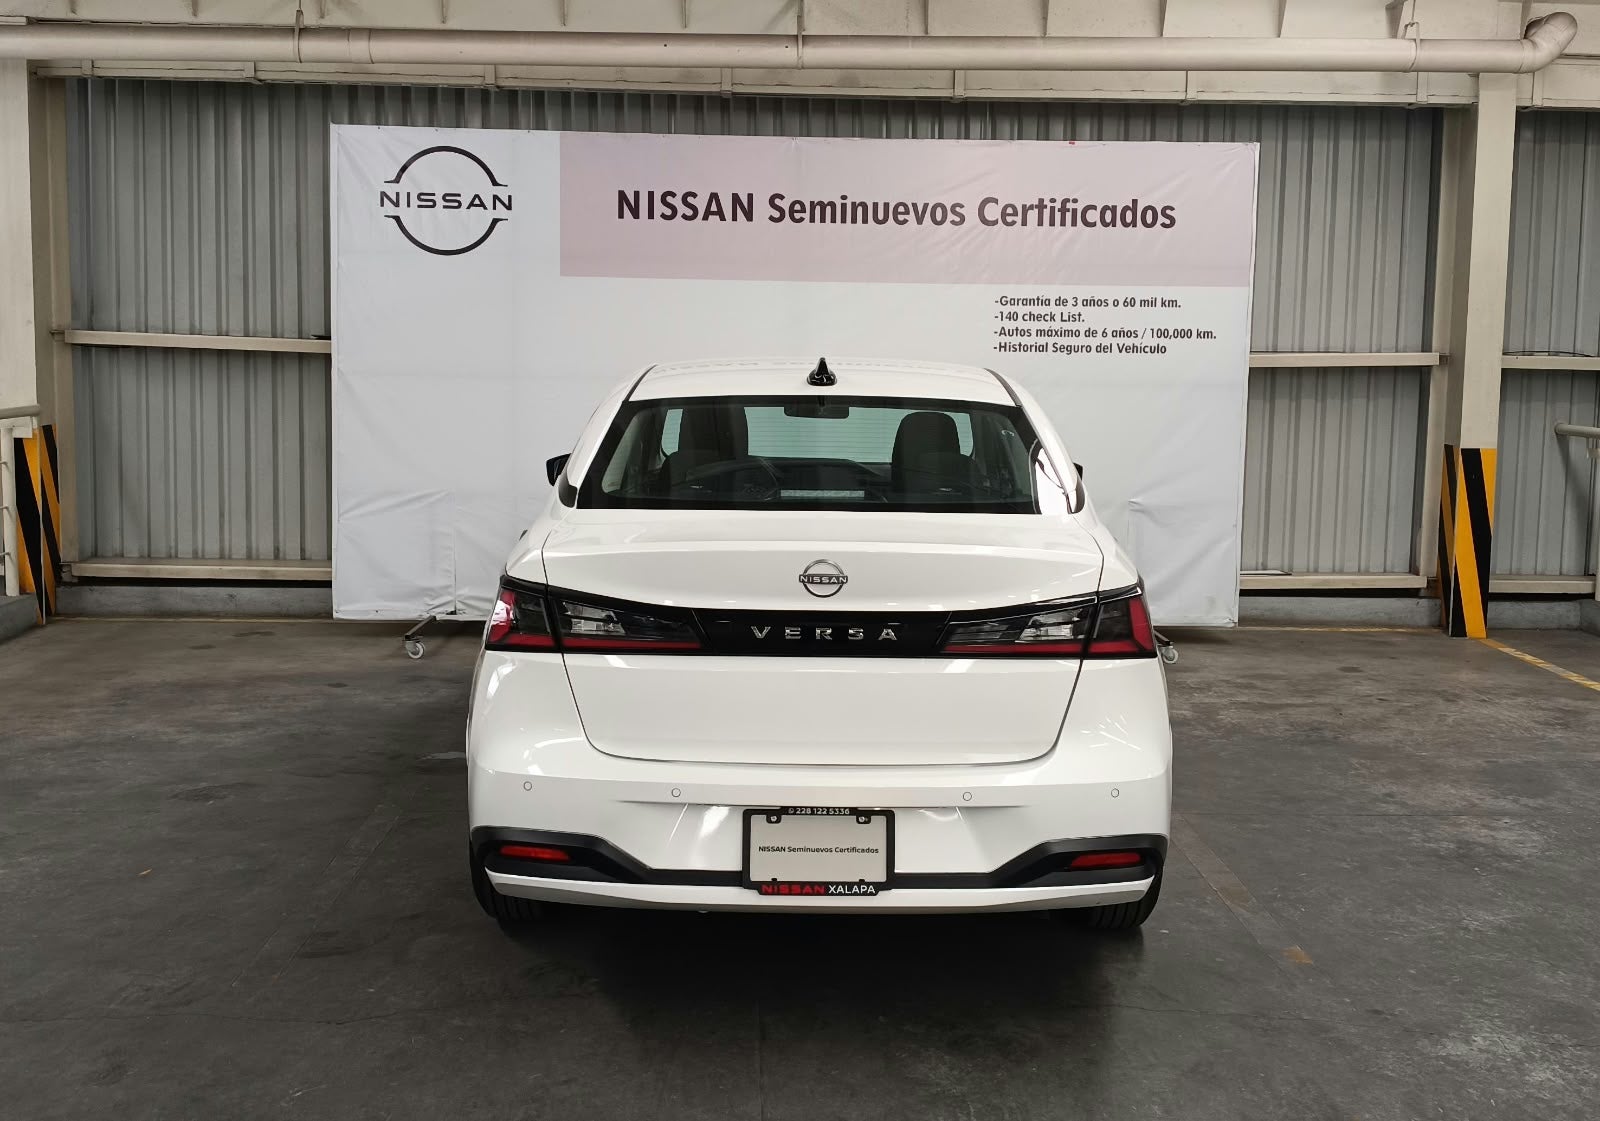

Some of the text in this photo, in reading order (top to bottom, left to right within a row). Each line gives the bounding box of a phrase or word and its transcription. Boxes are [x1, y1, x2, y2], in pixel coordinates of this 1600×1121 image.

[379, 190, 513, 211] NISSAN
[617, 189, 1177, 229] NISSAN Seminuevos Certificados
[995, 295, 1181, 308] -Garantía de 3 años o 60 mil km.
[995, 311, 1085, 322] -140 check List.
[994, 326, 1216, 339] -Autos máximo de 6 años / 100,000 km.
[994, 342, 1166, 355] -Historial Seguro del Vehículo
[800, 575, 847, 584] NISSAN
[751, 626, 897, 640] VERSA
[813, 807, 827, 815] 122
[762, 884, 875, 894] NISSAN XALAPA
